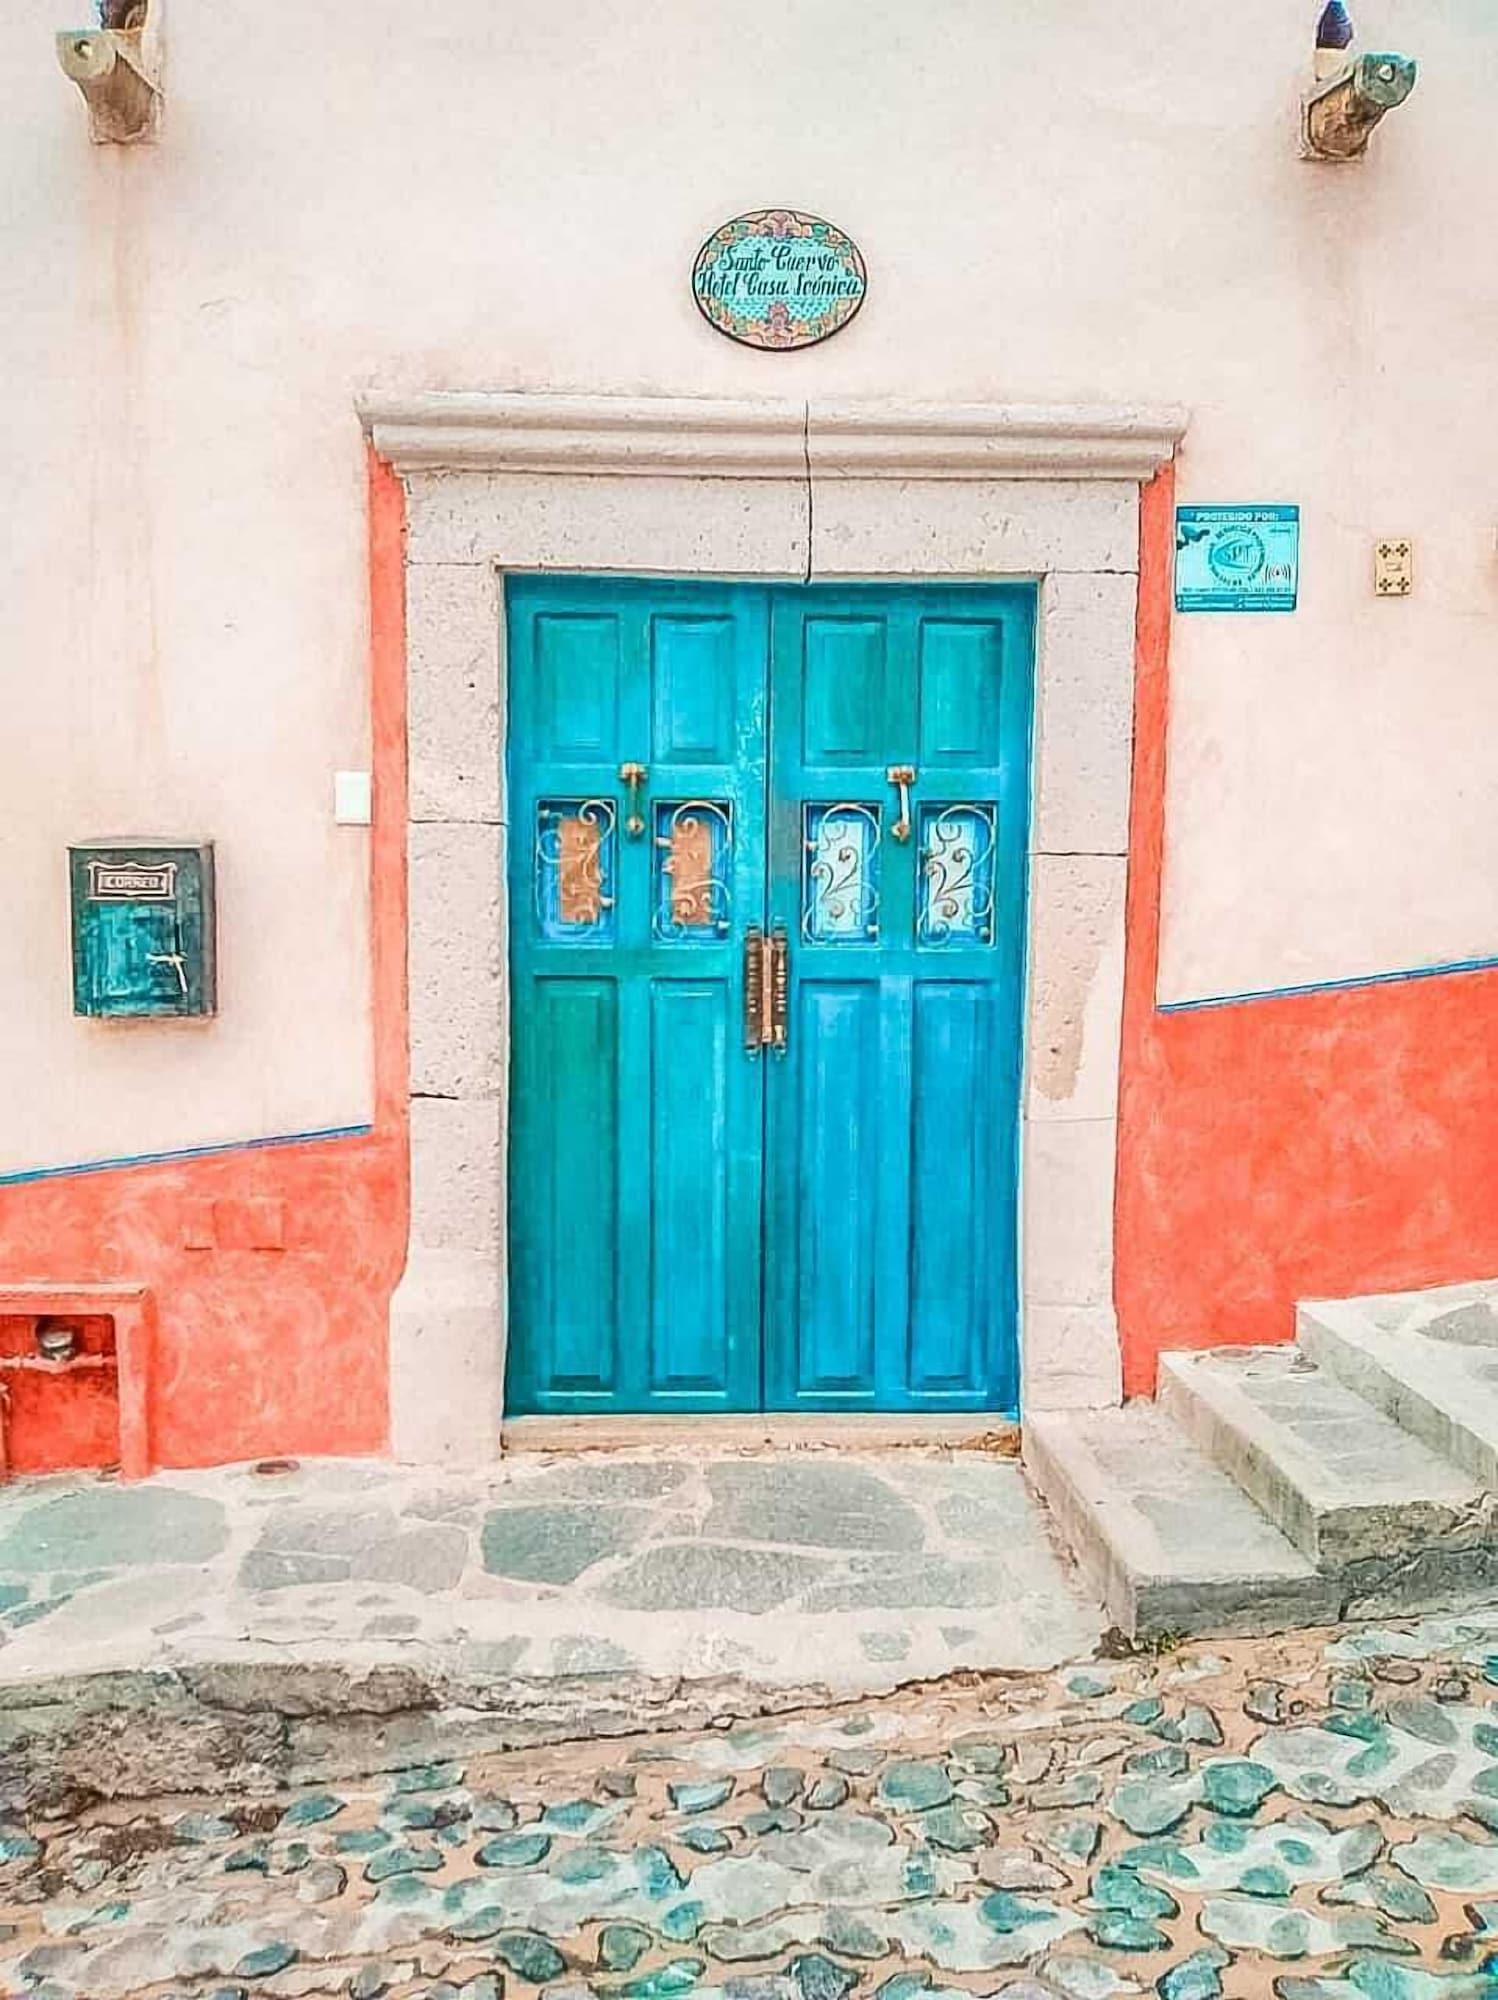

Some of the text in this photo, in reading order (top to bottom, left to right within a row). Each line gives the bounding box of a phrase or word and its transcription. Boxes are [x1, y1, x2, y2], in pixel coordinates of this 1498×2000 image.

[719, 244, 839, 271] Santo Cuervo
[698, 273, 861, 297] Hotel Casa Icónica
